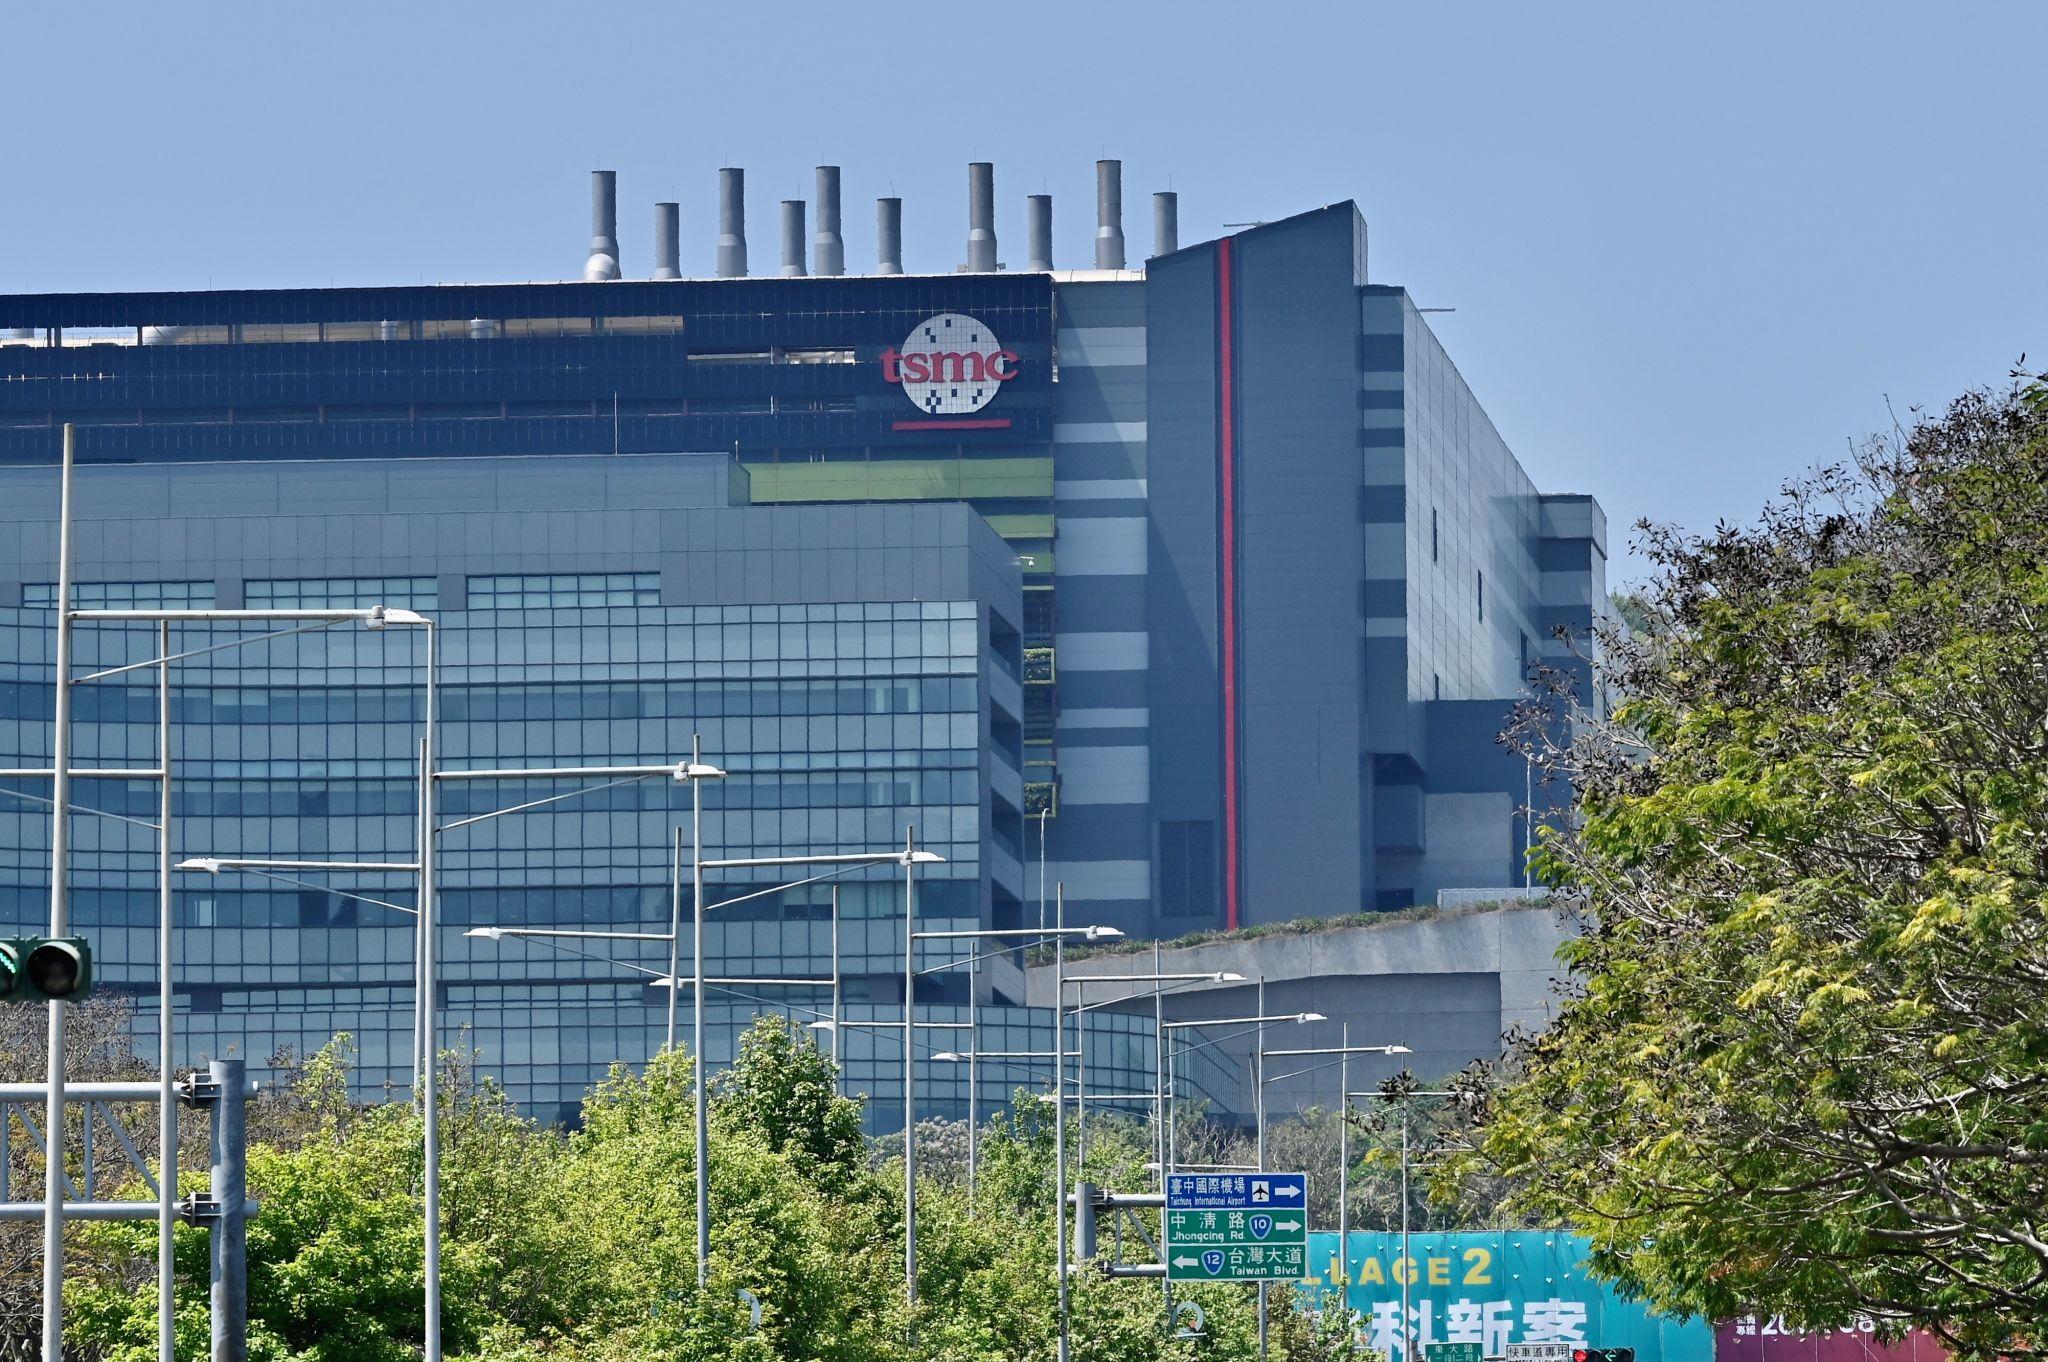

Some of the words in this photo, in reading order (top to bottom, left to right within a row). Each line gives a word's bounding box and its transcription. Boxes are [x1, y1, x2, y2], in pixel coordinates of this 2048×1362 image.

[880, 346, 1020, 384] tsmc
[1170, 1177, 1246, 1195] 臺中國際機場
[1171, 1197, 1192, 1207] Taichung
[1195, 1196, 1225, 1206] International
[1227, 1196, 1246, 1207] Airport
[1171, 1212, 1246, 1229] 中清路
[1253, 1219, 1267, 1230] 10
[1172, 1231, 1224, 1243] Jhongcing
[1230, 1231, 1246, 1240] Rd.
[1207, 1254, 1220, 1265] 12
[1229, 1247, 1302, 1265] 台灣大道
[1230, 1266, 1267, 1276] Taiwan
[1274, 1265, 1300, 1276] Blvd.
